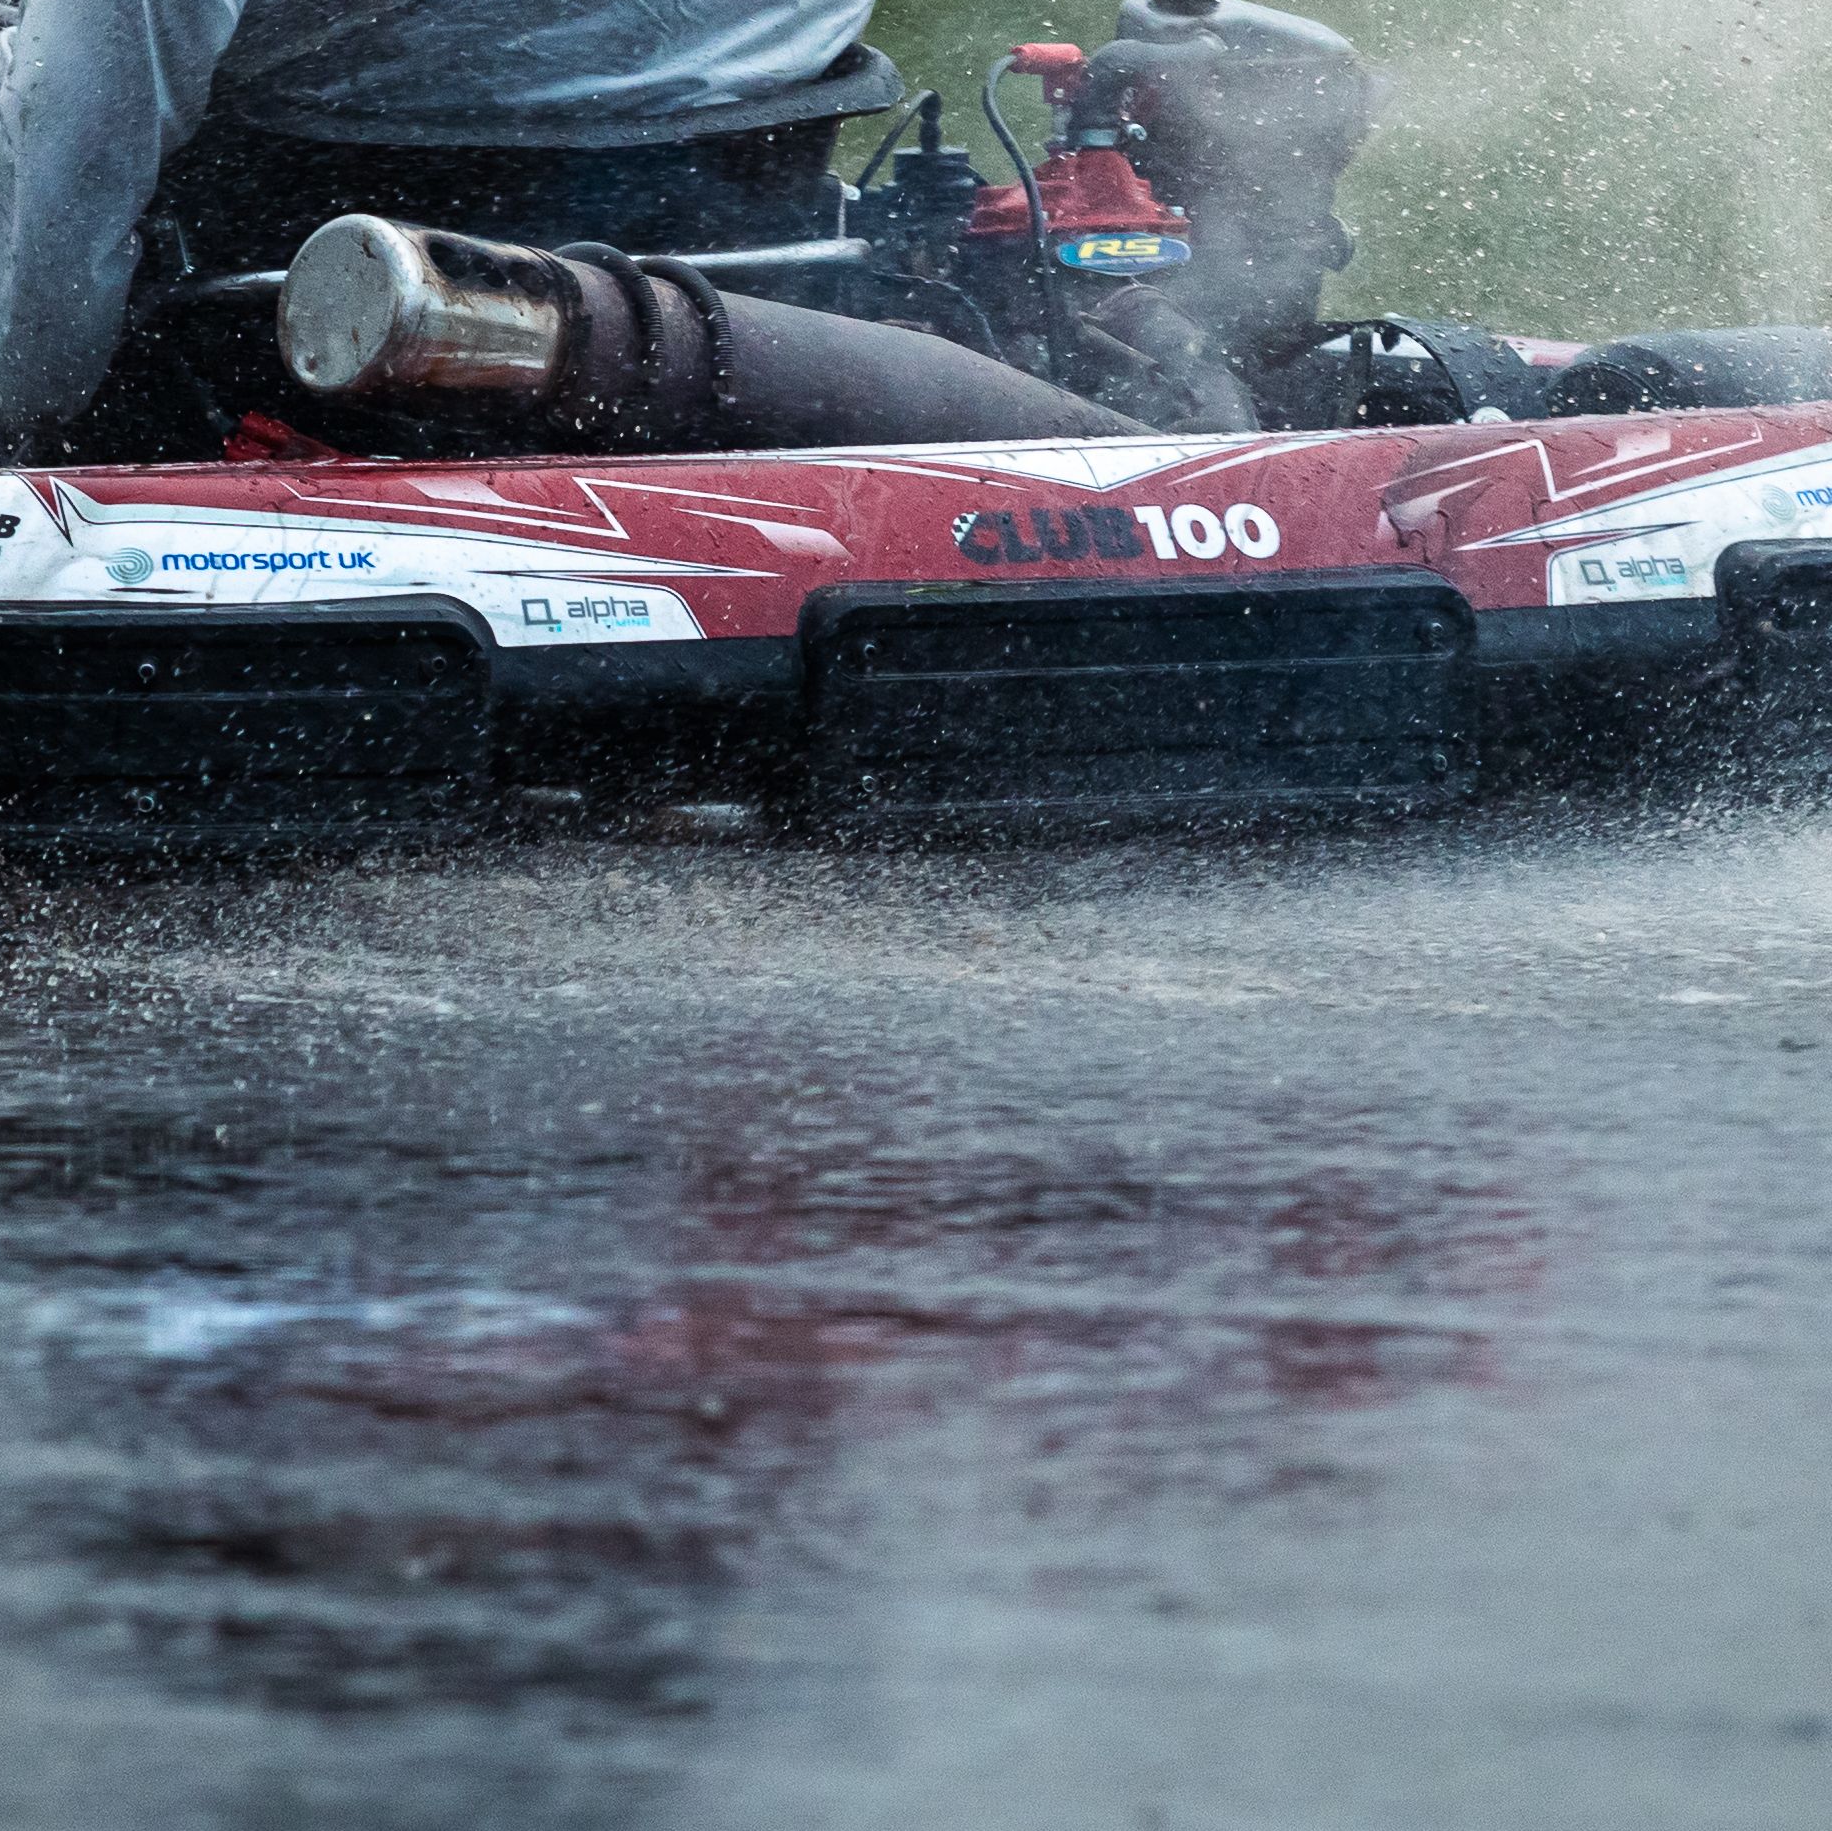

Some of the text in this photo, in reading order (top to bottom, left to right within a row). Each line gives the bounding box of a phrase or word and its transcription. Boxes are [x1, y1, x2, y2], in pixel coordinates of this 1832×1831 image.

[161, 549, 334, 574] motorsport
[1615, 555, 1686, 583] alpha
[565, 596, 650, 624] alpha
